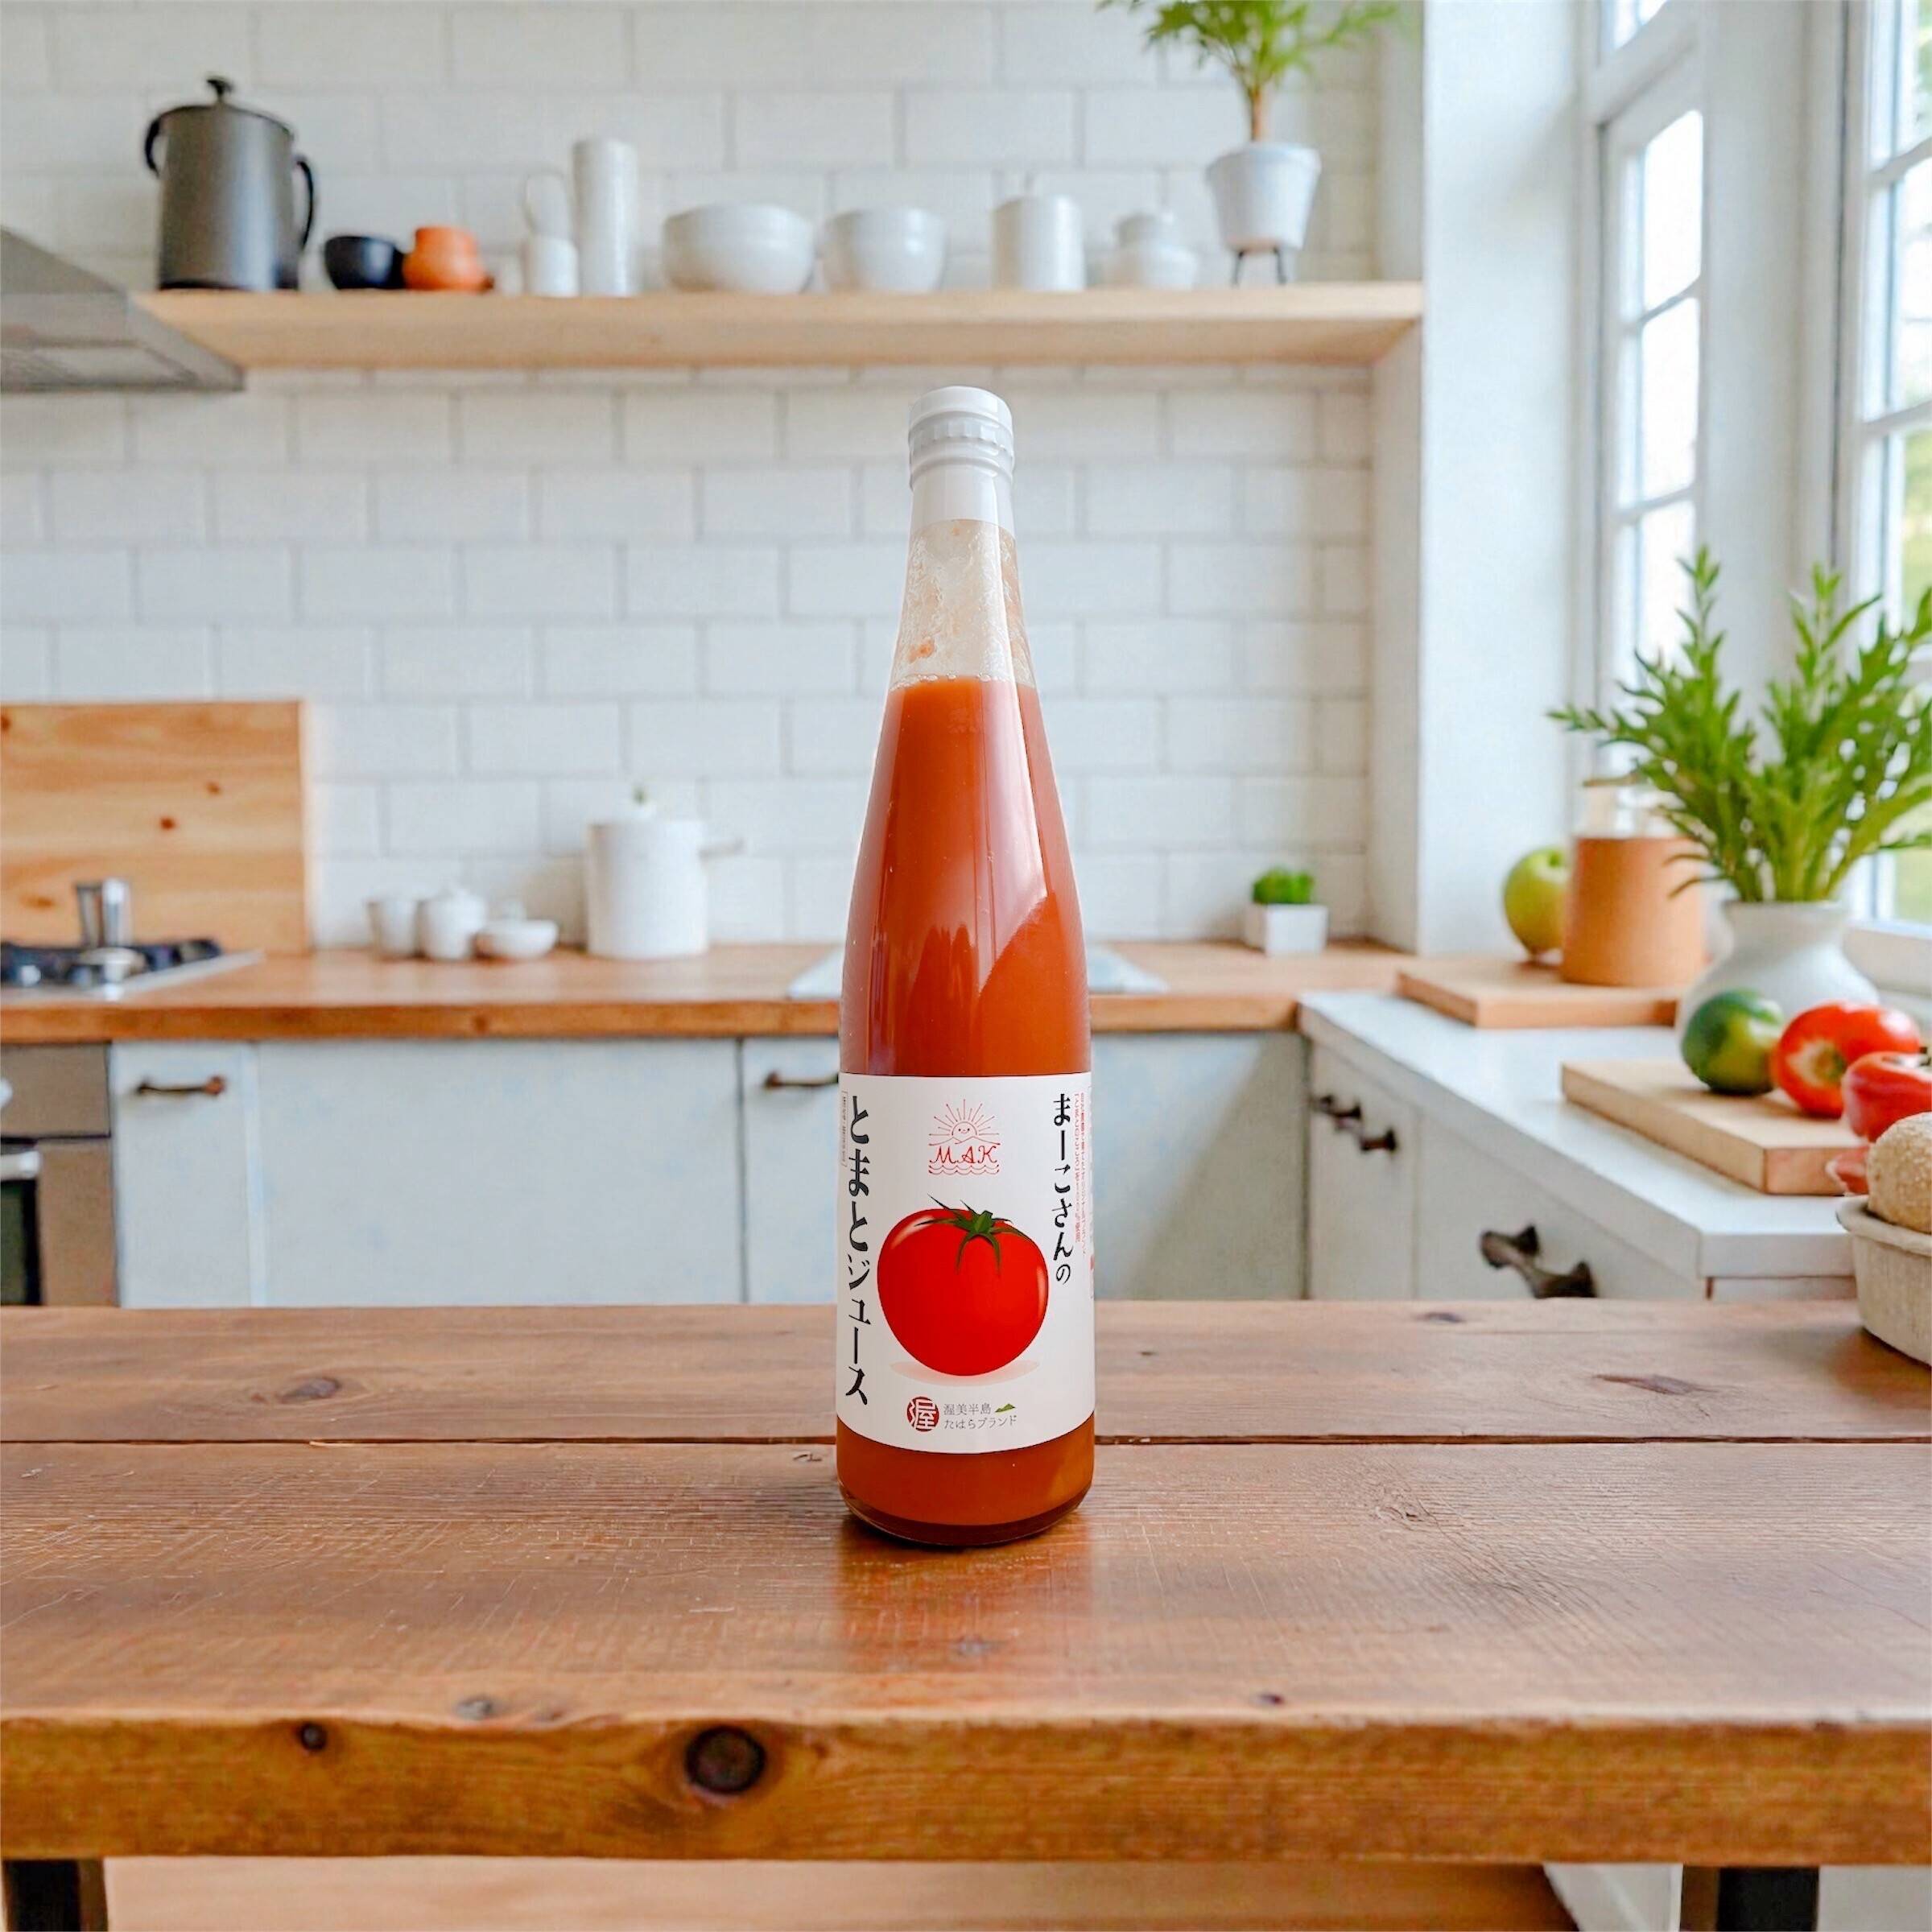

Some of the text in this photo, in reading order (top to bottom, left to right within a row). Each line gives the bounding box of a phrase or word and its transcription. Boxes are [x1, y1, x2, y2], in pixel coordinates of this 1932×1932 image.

[930, 1146, 997, 1164] MAK
[1051, 1093, 1073, 1285] まーこさんの
[845, 1096, 871, 1406] とまとジュース
[943, 1402, 992, 1415] 渥美半島
[943, 1414, 1017, 1430] たはらブランド
